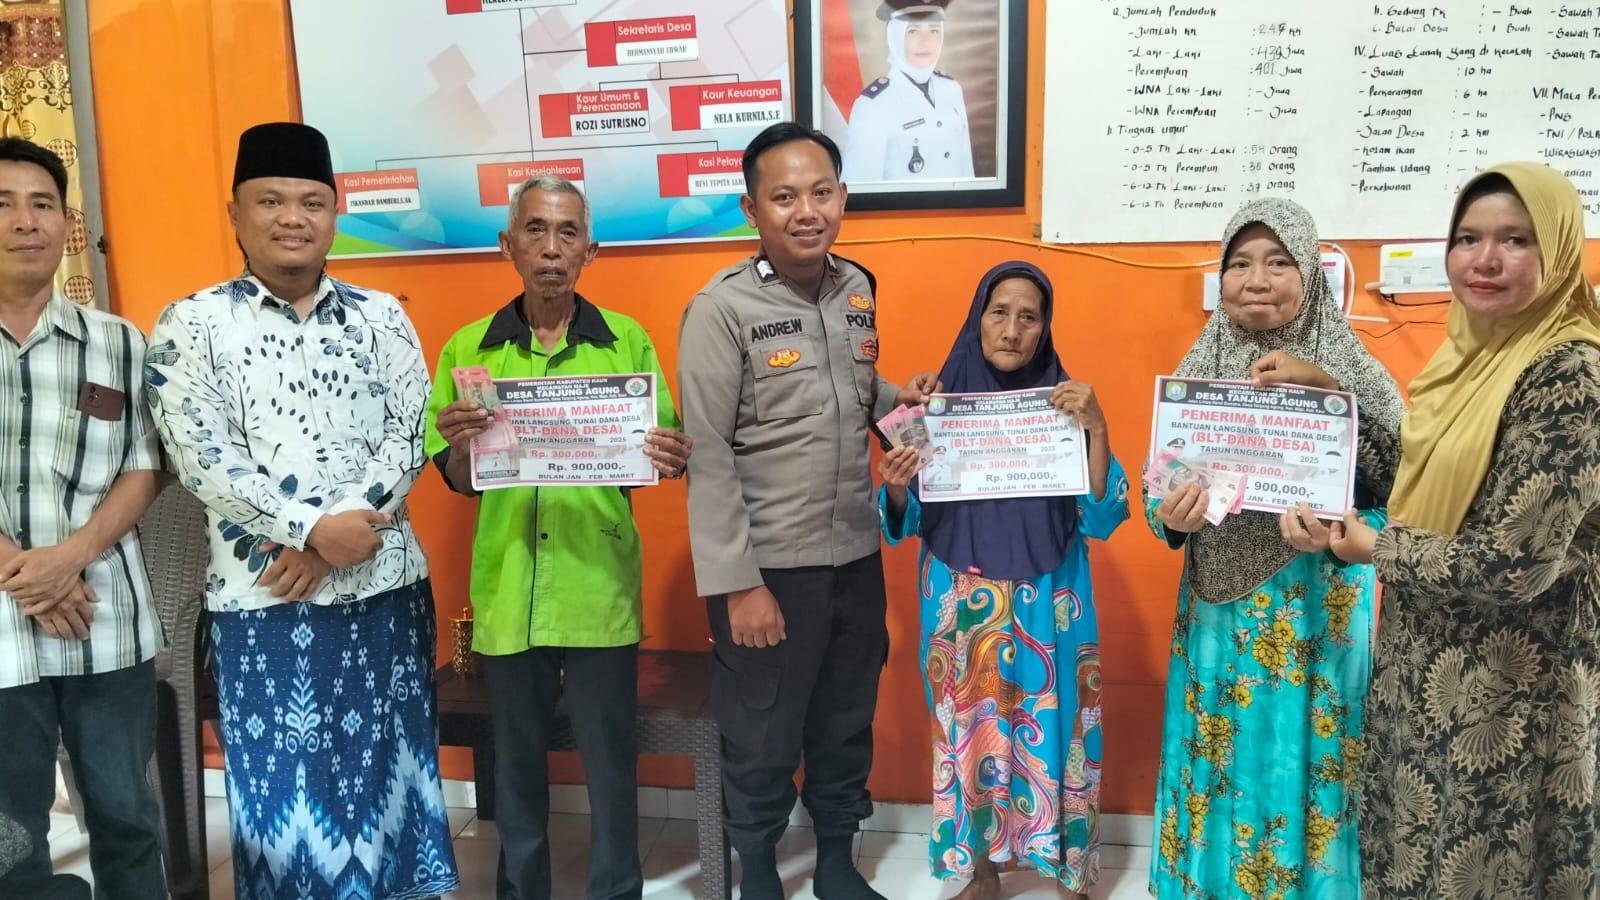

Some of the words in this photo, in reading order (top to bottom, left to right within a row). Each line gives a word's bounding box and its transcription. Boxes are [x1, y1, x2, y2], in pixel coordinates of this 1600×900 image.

[1169, 4, 1216, 17] Penduduk
[1387, 5, 1426, 19] Gedung
[1509, 5, 1532, 17] Buah
[617, 23, 664, 35] Sekretaris
[667, 22, 692, 32] Desa
[1385, 20, 1416, 35] Balai
[1423, 24, 1449, 33] Desa
[1506, 23, 1530, 34] Buah
[1480, 65, 1492, 76] ha
[576, 94, 598, 104] Kaur
[600, 92, 631, 102] Umum
[633, 91, 640, 100] &
[702, 89, 725, 100] Kaur
[727, 87, 778, 98] Keuangan
[576, 101, 641, 112] Perencanaan
[1166, 104, 1217, 117] Perempuan
[714, 113, 734, 123] NELA
[1549, 106, 1572, 122] PNS
[575, 120, 598, 130] ROZI
[600, 117, 646, 129] SUTRISNO
[1395, 124, 1425, 139] Desa
[698, 156, 715, 168] Kasi
[716, 156, 743, 168] Pelaya
[1360, 161, 1396, 173] Tambak
[507, 167, 523, 177] Kasi
[526, 165, 581, 177] Kesejahteraan
[344, 178, 360, 187] Kasi
[361, 175, 415, 186] Pemerintahan
[1174, 198, 1224, 210] Perempuan
[751, 318, 803, 342] ANDREW
[506, 391, 534, 399] DESA
[536, 388, 583, 398] TANJUNG
[585, 386, 620, 396] AGUNG
[952, 404, 973, 412] DESA
[975, 402, 1016, 412] TANJUNG
[1018, 399, 1048, 409] AGUNG
[1195, 392, 1224, 401] DESA
[1226, 394, 1279, 405] TANJUNG
[1281, 397, 1319, 409] AGUNG
[504, 407, 567, 418] ENERIMA
[571, 403, 633, 416] MANFAAT
[941, 419, 1001, 430] PENERIMA
[1004, 414, 1060, 427] MANFAAT
[1181, 409, 1257, 425] PENERIMA
[1261, 414, 1330, 431] MANFAAT
[513, 425, 579, 436] BLT-DANA
[583, 424, 623, 435] DESA)
[966, 430, 1005, 438] LANGSUNG
[1171, 421, 1211, 430] BANTUAN
[1213, 424, 1260, 435] LANGSUNG
[1263, 428, 1288, 437] TUNAI
[1291, 431, 1314, 440] DANA
[1316, 433, 1338, 442] DESA
[518, 436, 546, 444] TAHUN
[548, 436, 595, 444] ANGGARAN
[950, 437, 1013, 449] (BLT-DANA
[1015, 434, 1052, 445] DESA)
[1191, 432, 1267, 449] (BLT-DANA
[1272, 438, 1316, 453] DESA)
[531, 450, 547, 459] Rp.
[1200, 445, 1231, 455] TAHUN
[1233, 448, 1284, 459] ANGGARAN
[1300, 455, 1319, 464] 2025
[548, 463, 567, 473] Rp.
[609, 472, 635, 480] MARET
[985, 473, 1003, 483] Rp.
[1254, 481, 1315, 498] 900,000,-
[1271, 497, 1288, 505] FEB
[1295, 501, 1325, 510] MRET
